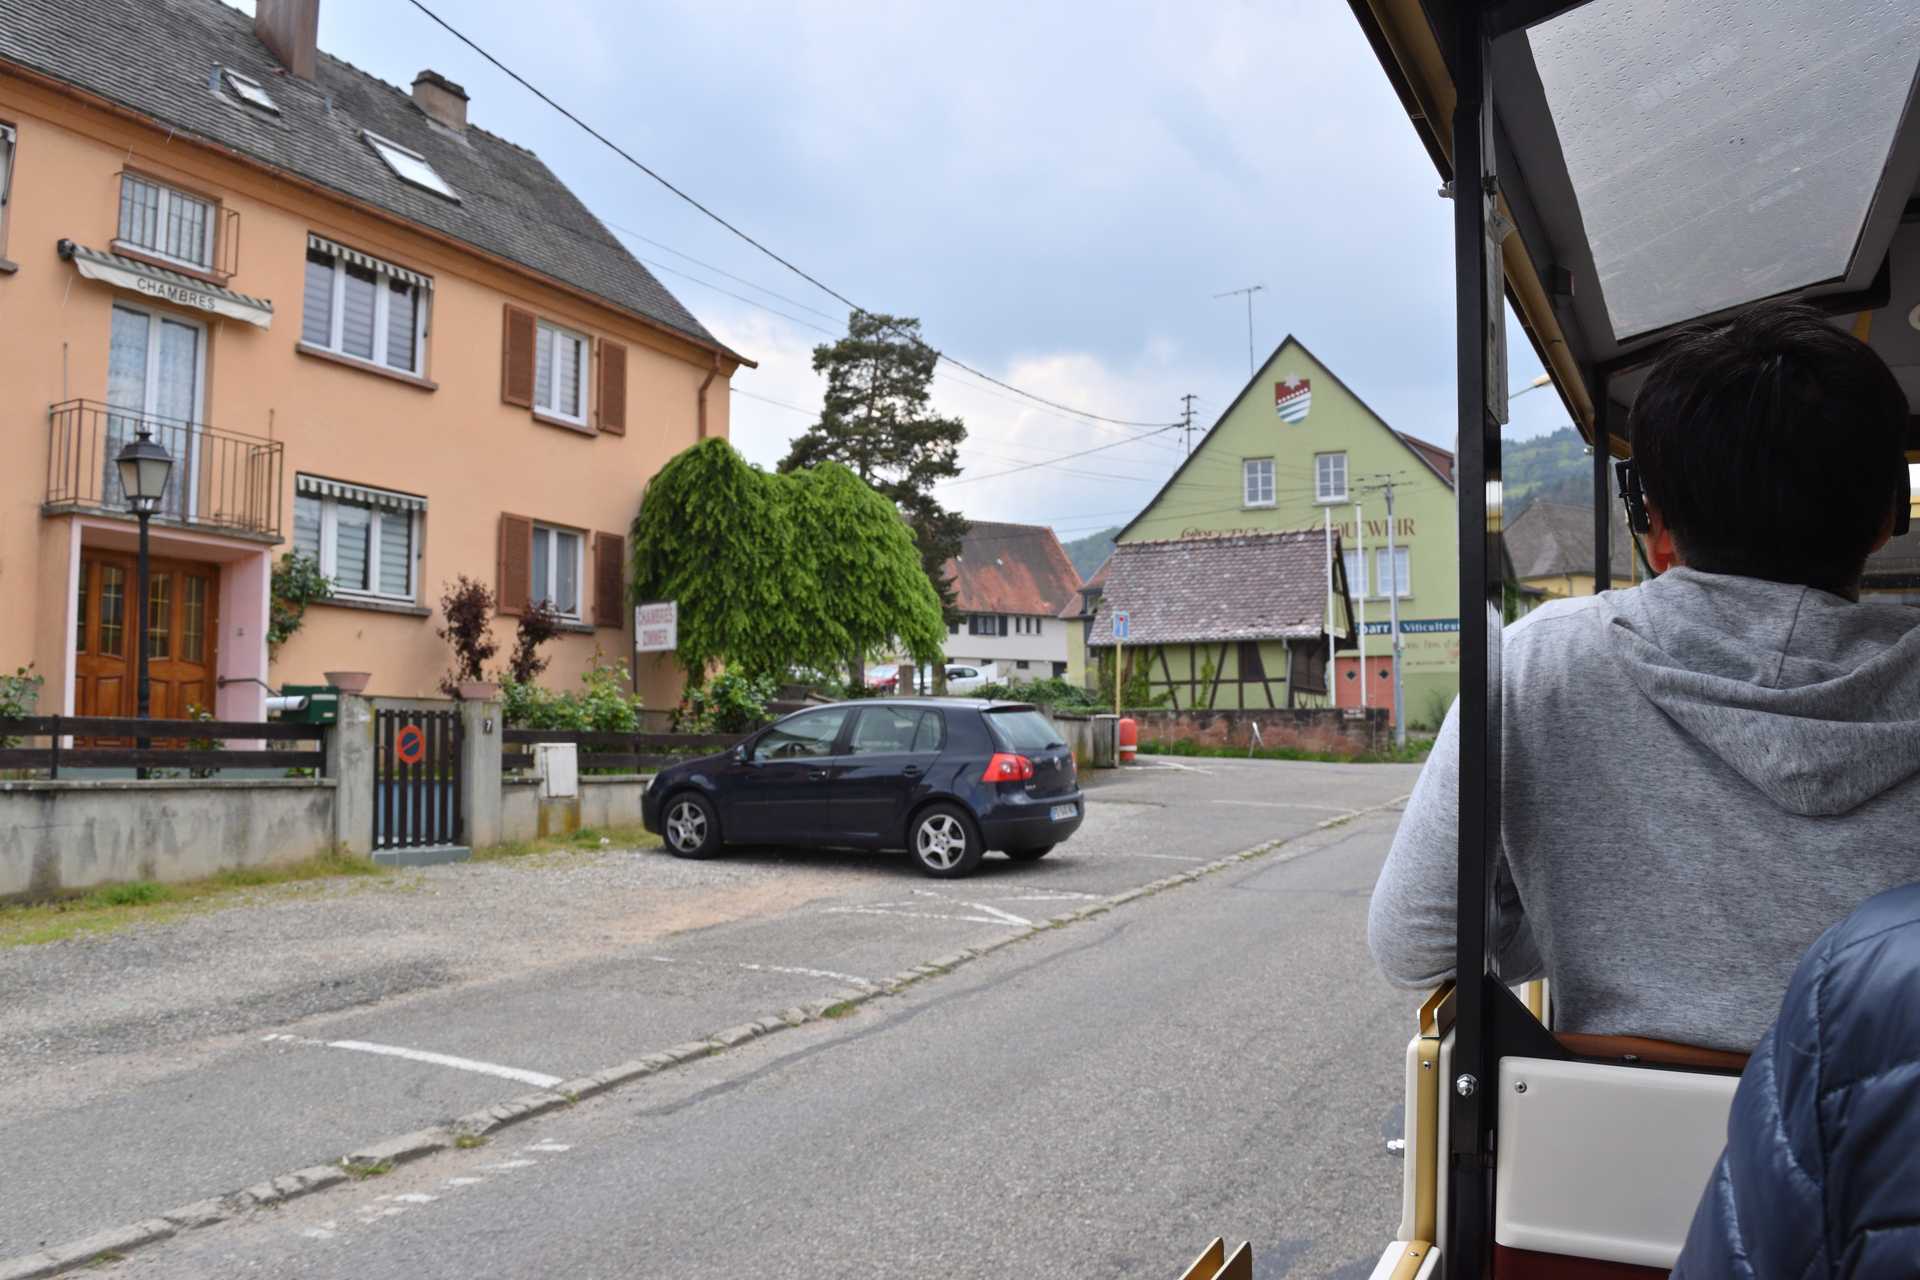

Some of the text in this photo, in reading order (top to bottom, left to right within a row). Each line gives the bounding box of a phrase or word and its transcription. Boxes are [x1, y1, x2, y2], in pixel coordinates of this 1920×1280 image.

[137, 278, 216, 309] CHAMBRES
[1404, 621, 1459, 631] Viticulteu
[486, 719, 492, 731] 7
